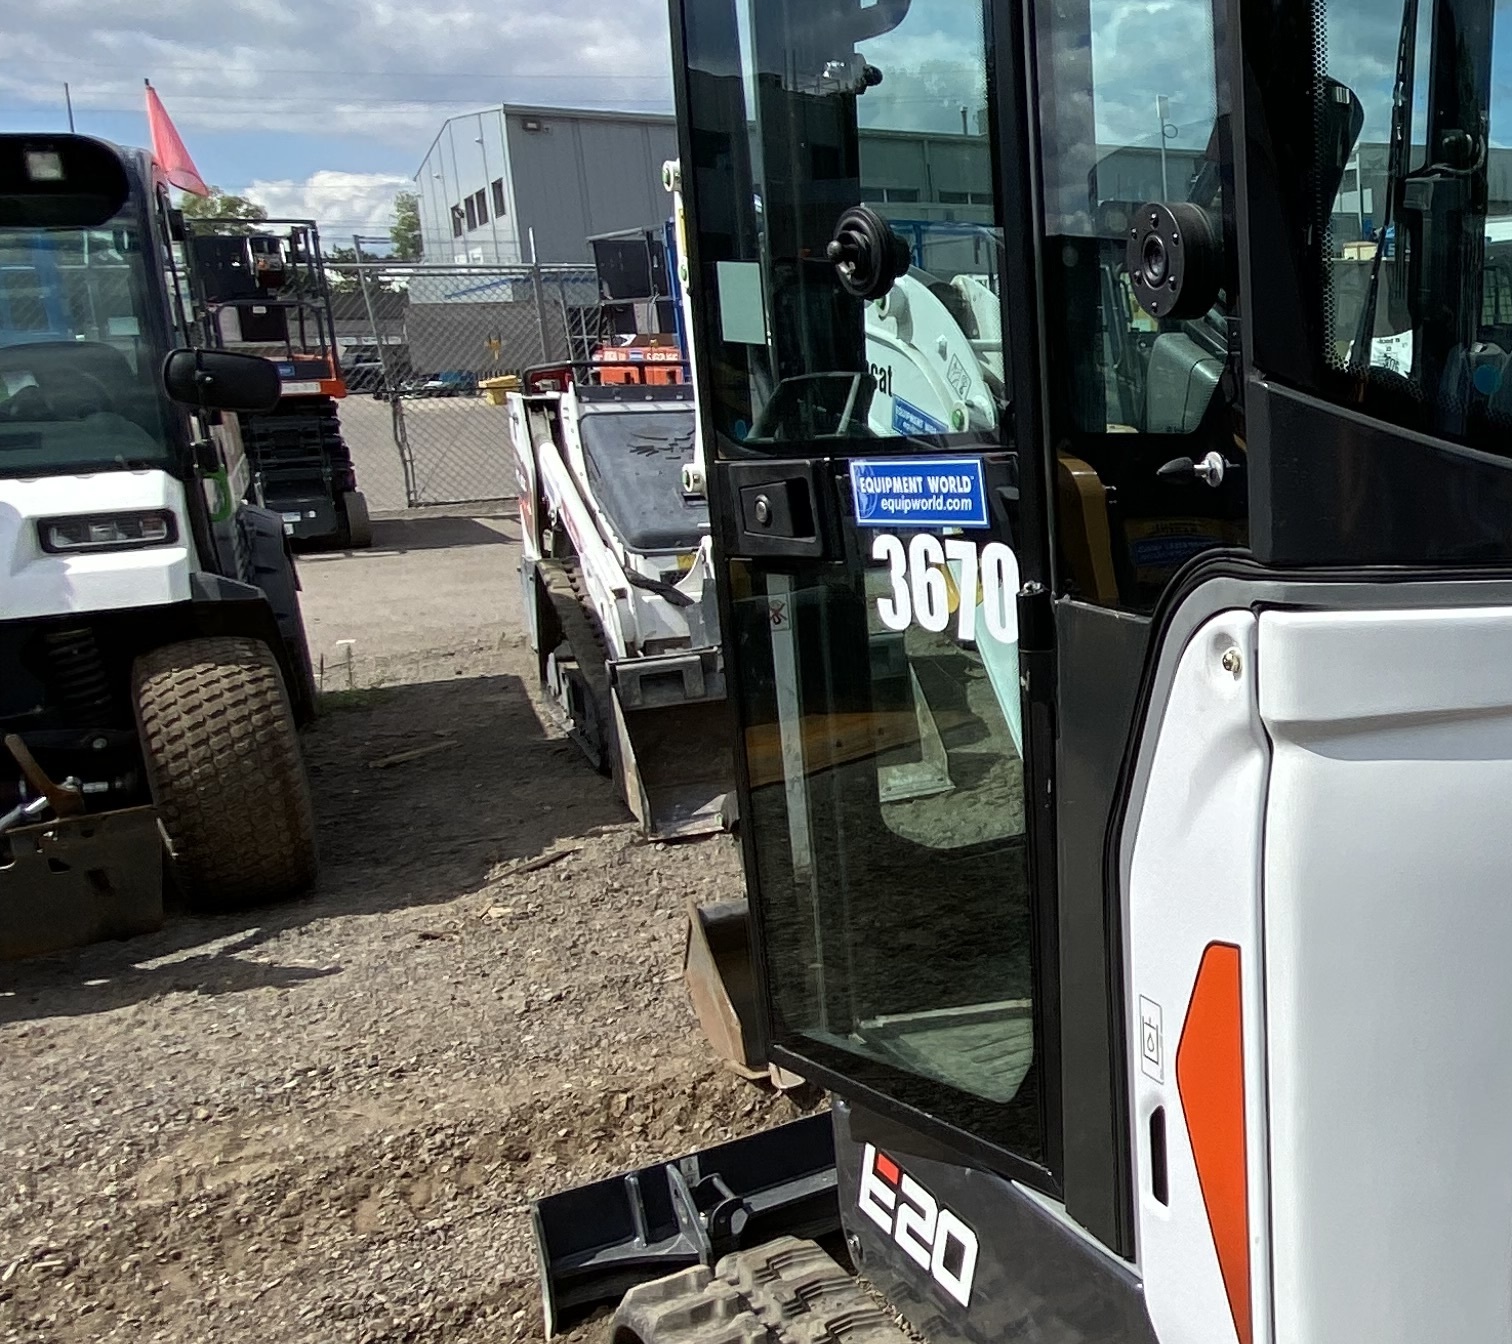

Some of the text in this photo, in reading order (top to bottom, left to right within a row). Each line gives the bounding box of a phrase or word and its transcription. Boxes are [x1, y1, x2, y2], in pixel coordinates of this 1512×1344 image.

[860, 476, 972, 494] EQUIPMENT WORLD
[881, 495, 972, 514] equipworld.com
[872, 533, 1021, 644] 3670
[858, 1142, 979, 1308] E20
